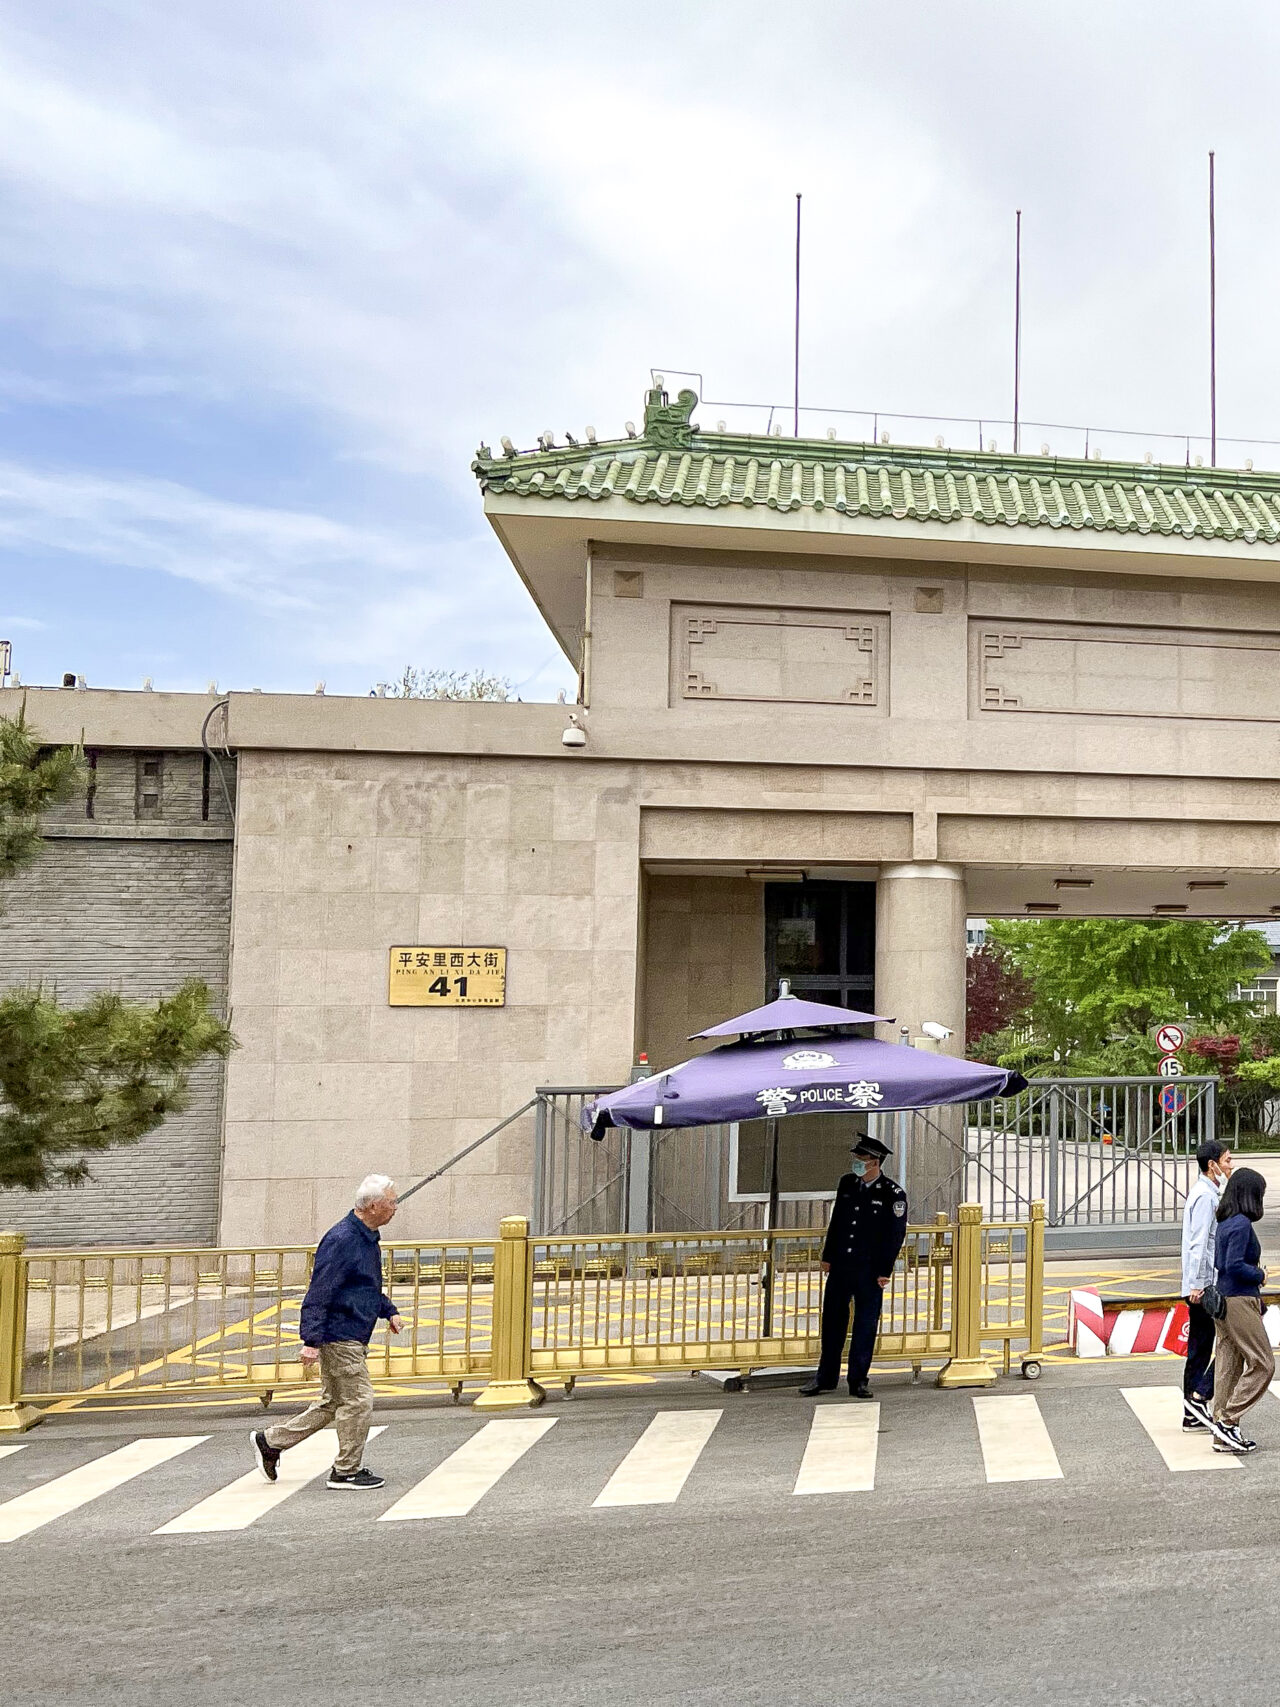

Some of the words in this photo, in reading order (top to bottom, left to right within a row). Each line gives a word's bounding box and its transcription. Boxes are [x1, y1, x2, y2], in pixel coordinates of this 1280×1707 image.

[398, 952, 498, 967] 平安里西大街
[428, 976, 467, 997] 41
[1164, 1061, 1179, 1076] 15
[756, 1086, 797, 1115] 警
[800, 1088, 844, 1103] POLICE
[844, 1080, 884, 1108] 察
